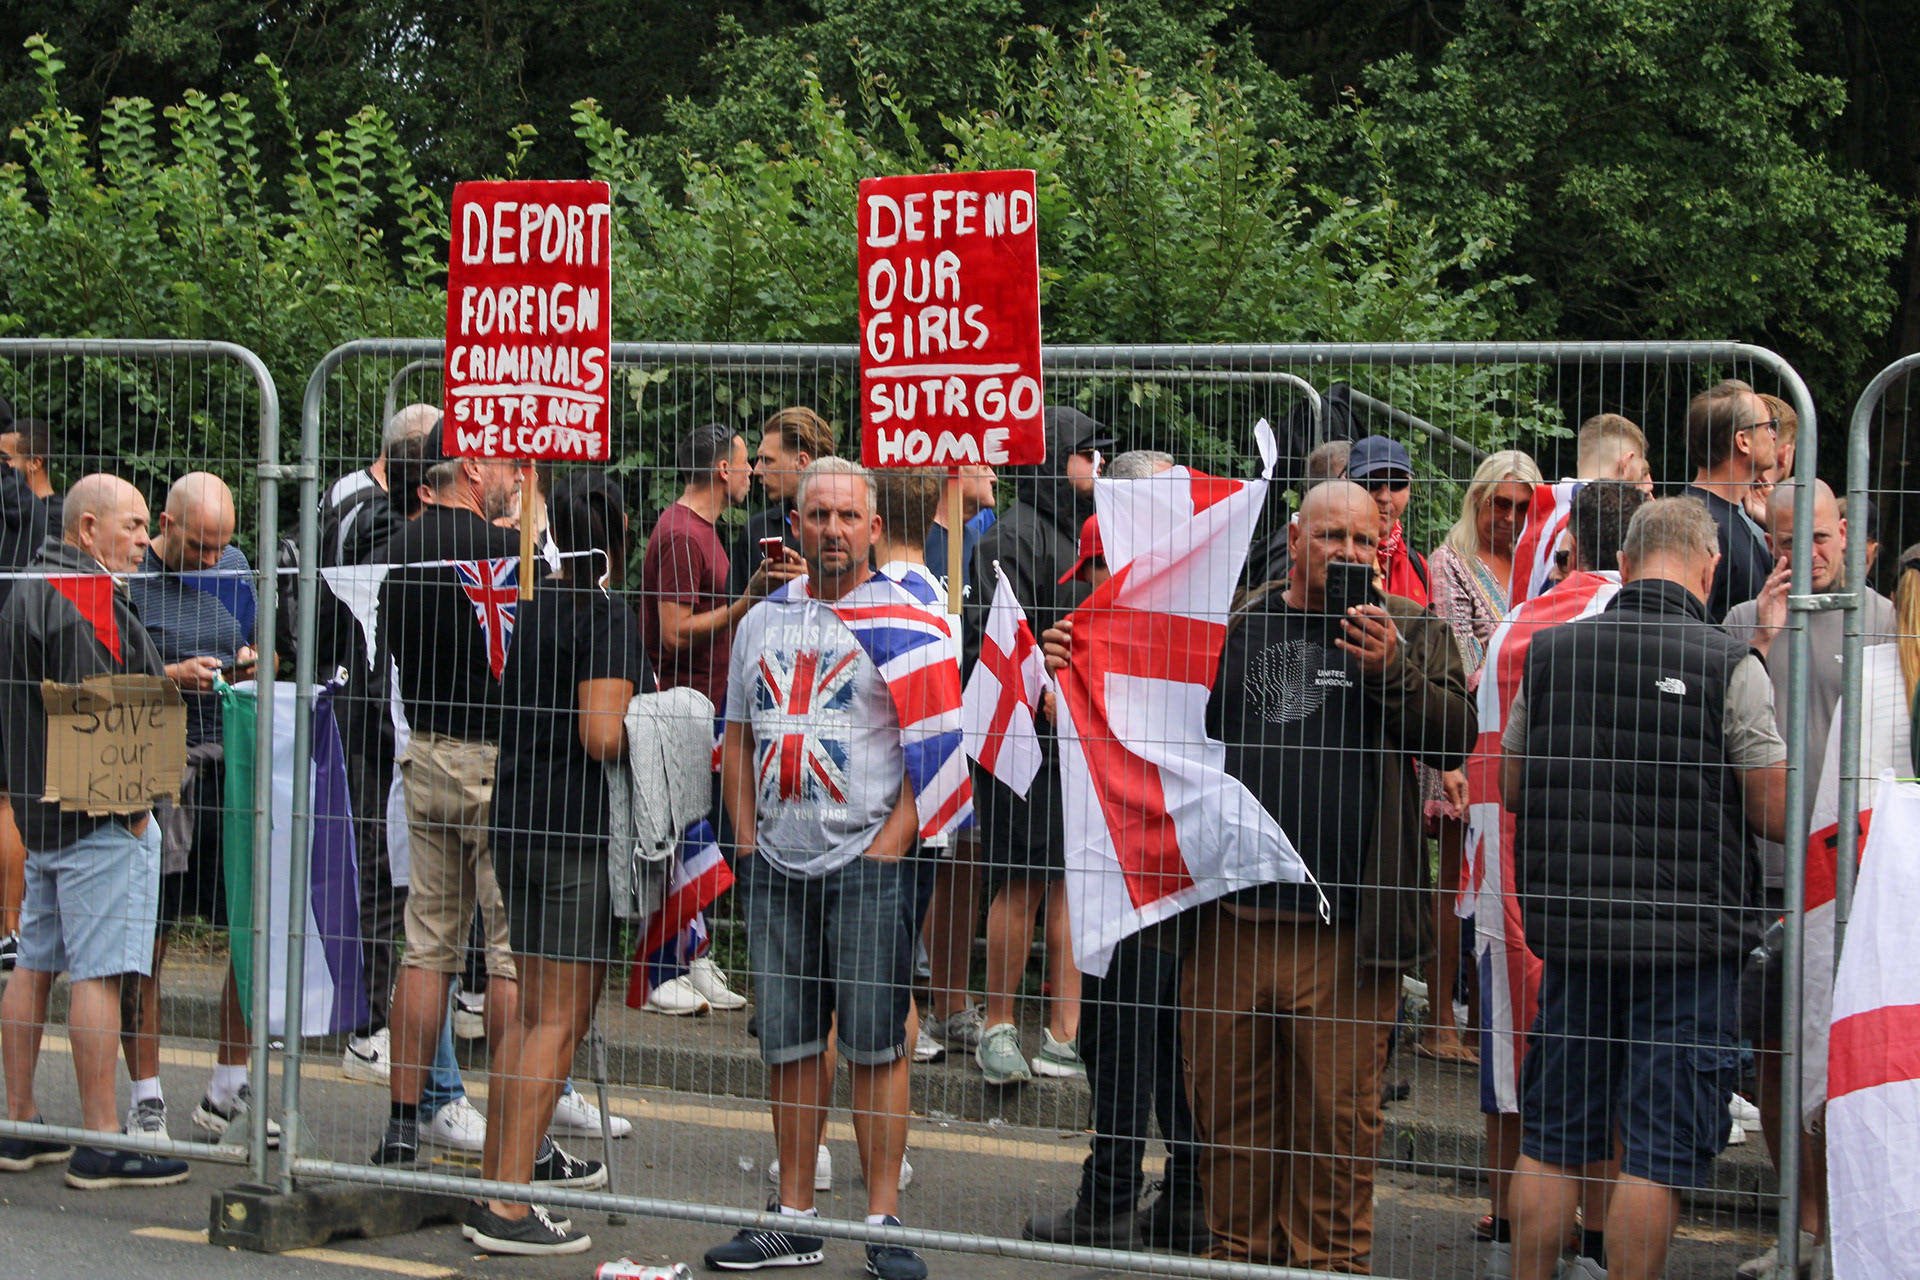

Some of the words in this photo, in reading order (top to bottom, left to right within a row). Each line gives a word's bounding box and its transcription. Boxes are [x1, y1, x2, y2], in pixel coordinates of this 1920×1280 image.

[462, 202, 610, 266] DEPORT
[866, 190, 1033, 247] DEFEND
[867, 250, 961, 310] OUR
[461, 282, 600, 336] FOREIGN
[866, 304, 990, 362] GIRLS
[450, 344, 605, 392] CRIMINALS
[454, 394, 538, 426] SUTR
[547, 397, 601, 430] NOT
[456, 424, 602, 459] WELCOME
[877, 427, 1010, 465] HOME
[783, 623, 820, 646] THIS
[1314, 678, 1353, 688] KINGDOM
[71, 697, 166, 736] Save
[100, 742, 153, 766] our
[87, 768, 157, 804] Kids
